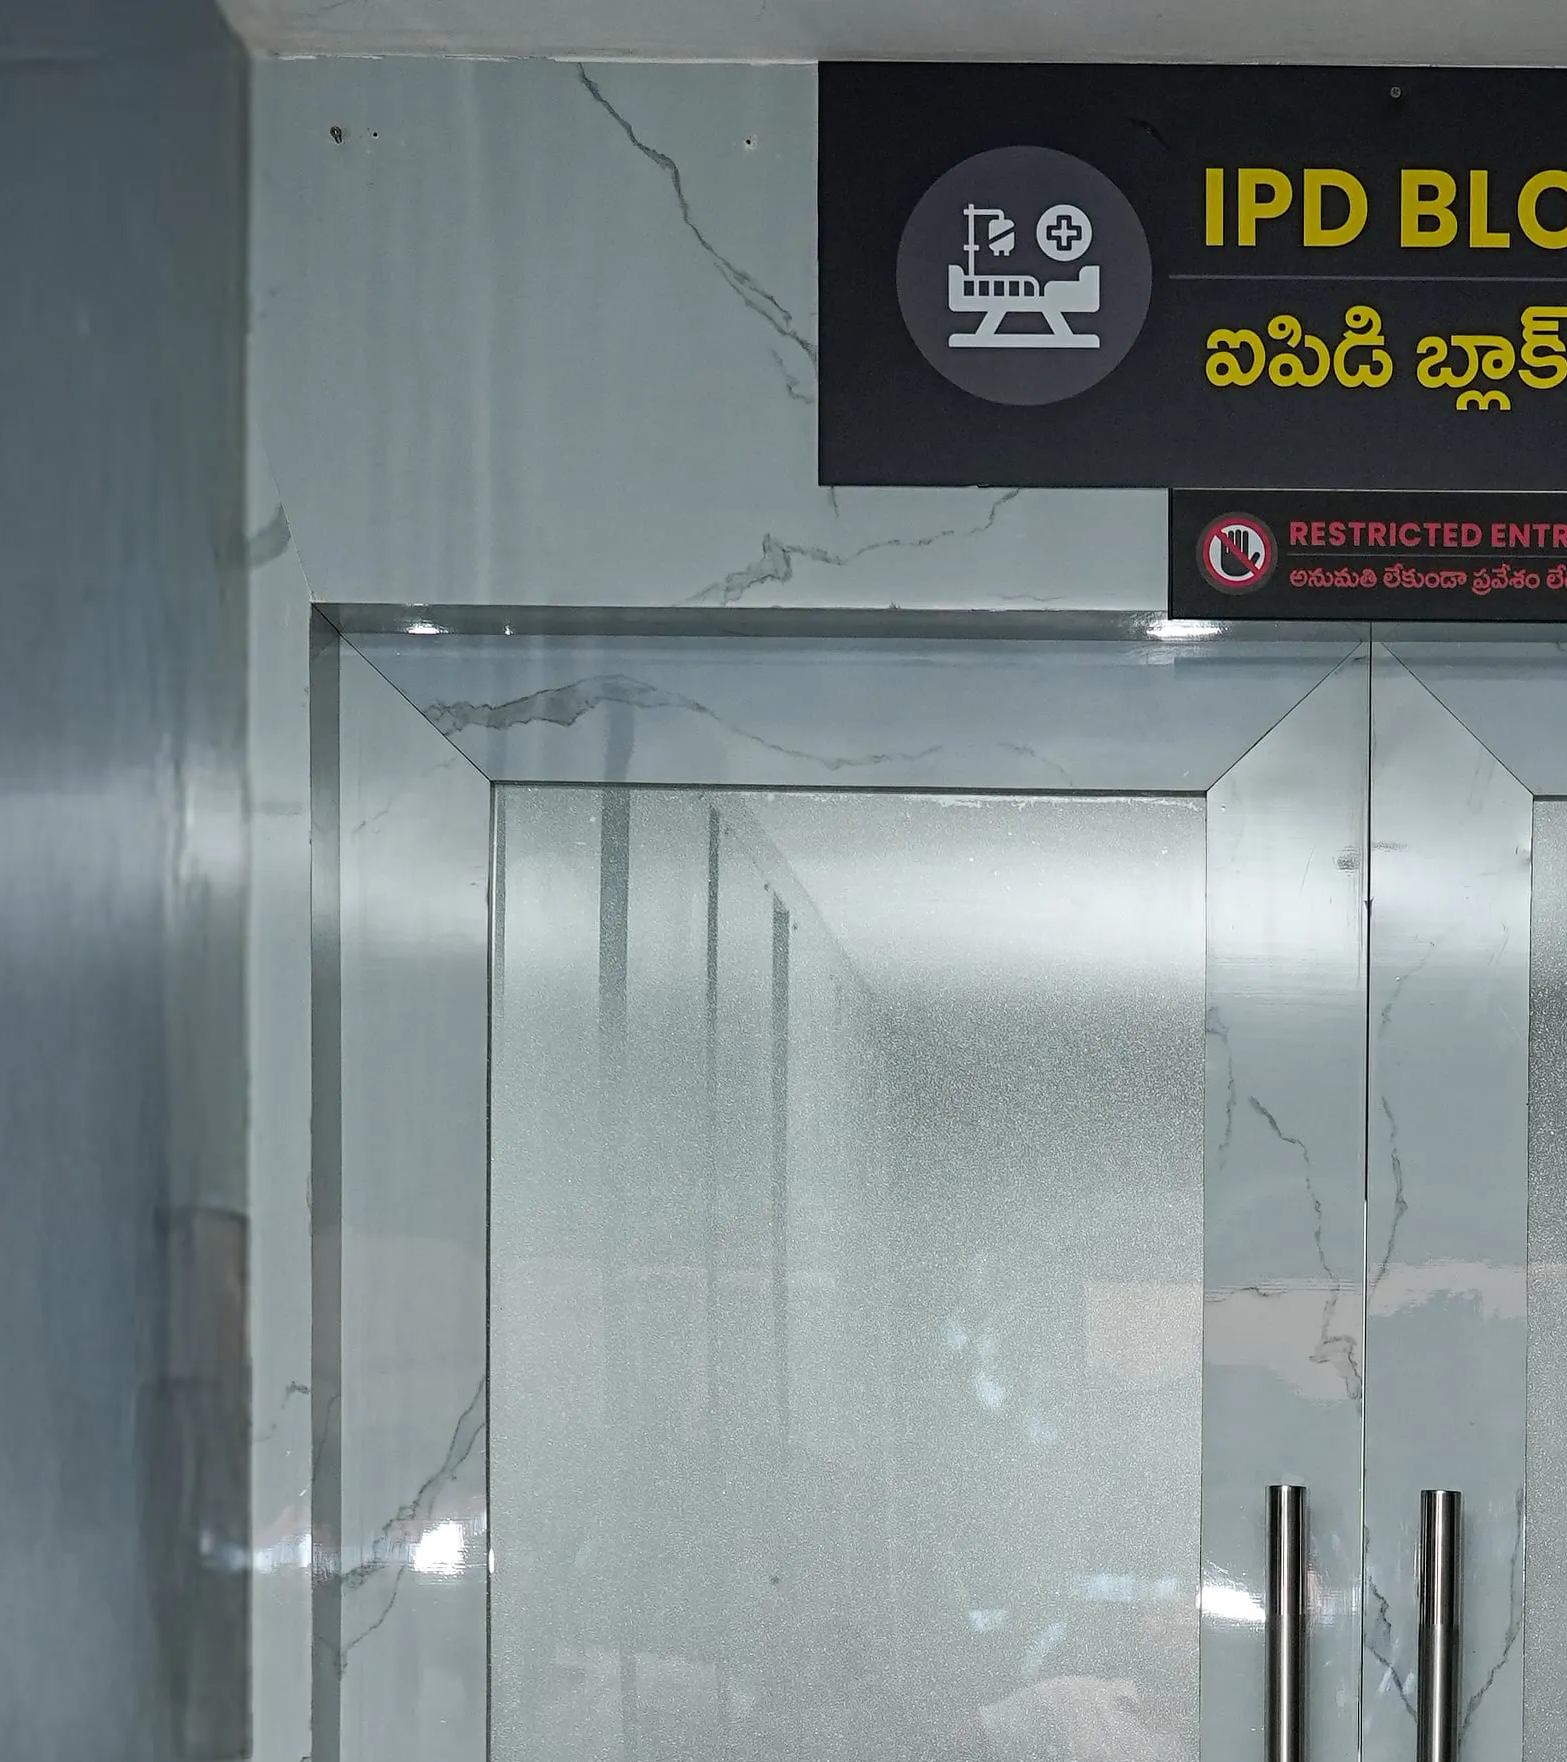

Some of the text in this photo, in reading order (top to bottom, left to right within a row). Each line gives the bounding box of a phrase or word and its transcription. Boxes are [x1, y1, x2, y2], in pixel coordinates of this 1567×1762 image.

[1205, 167, 1369, 247] IPD
[1205, 305, 1393, 388] ఐపిడి
[1289, 521, 1482, 547] RESTRICTED
[1289, 567, 1378, 588] అనుమతి
[1383, 562, 1467, 589] లేకుండా
[1472, 563, 1540, 595] ప్రవేశం
